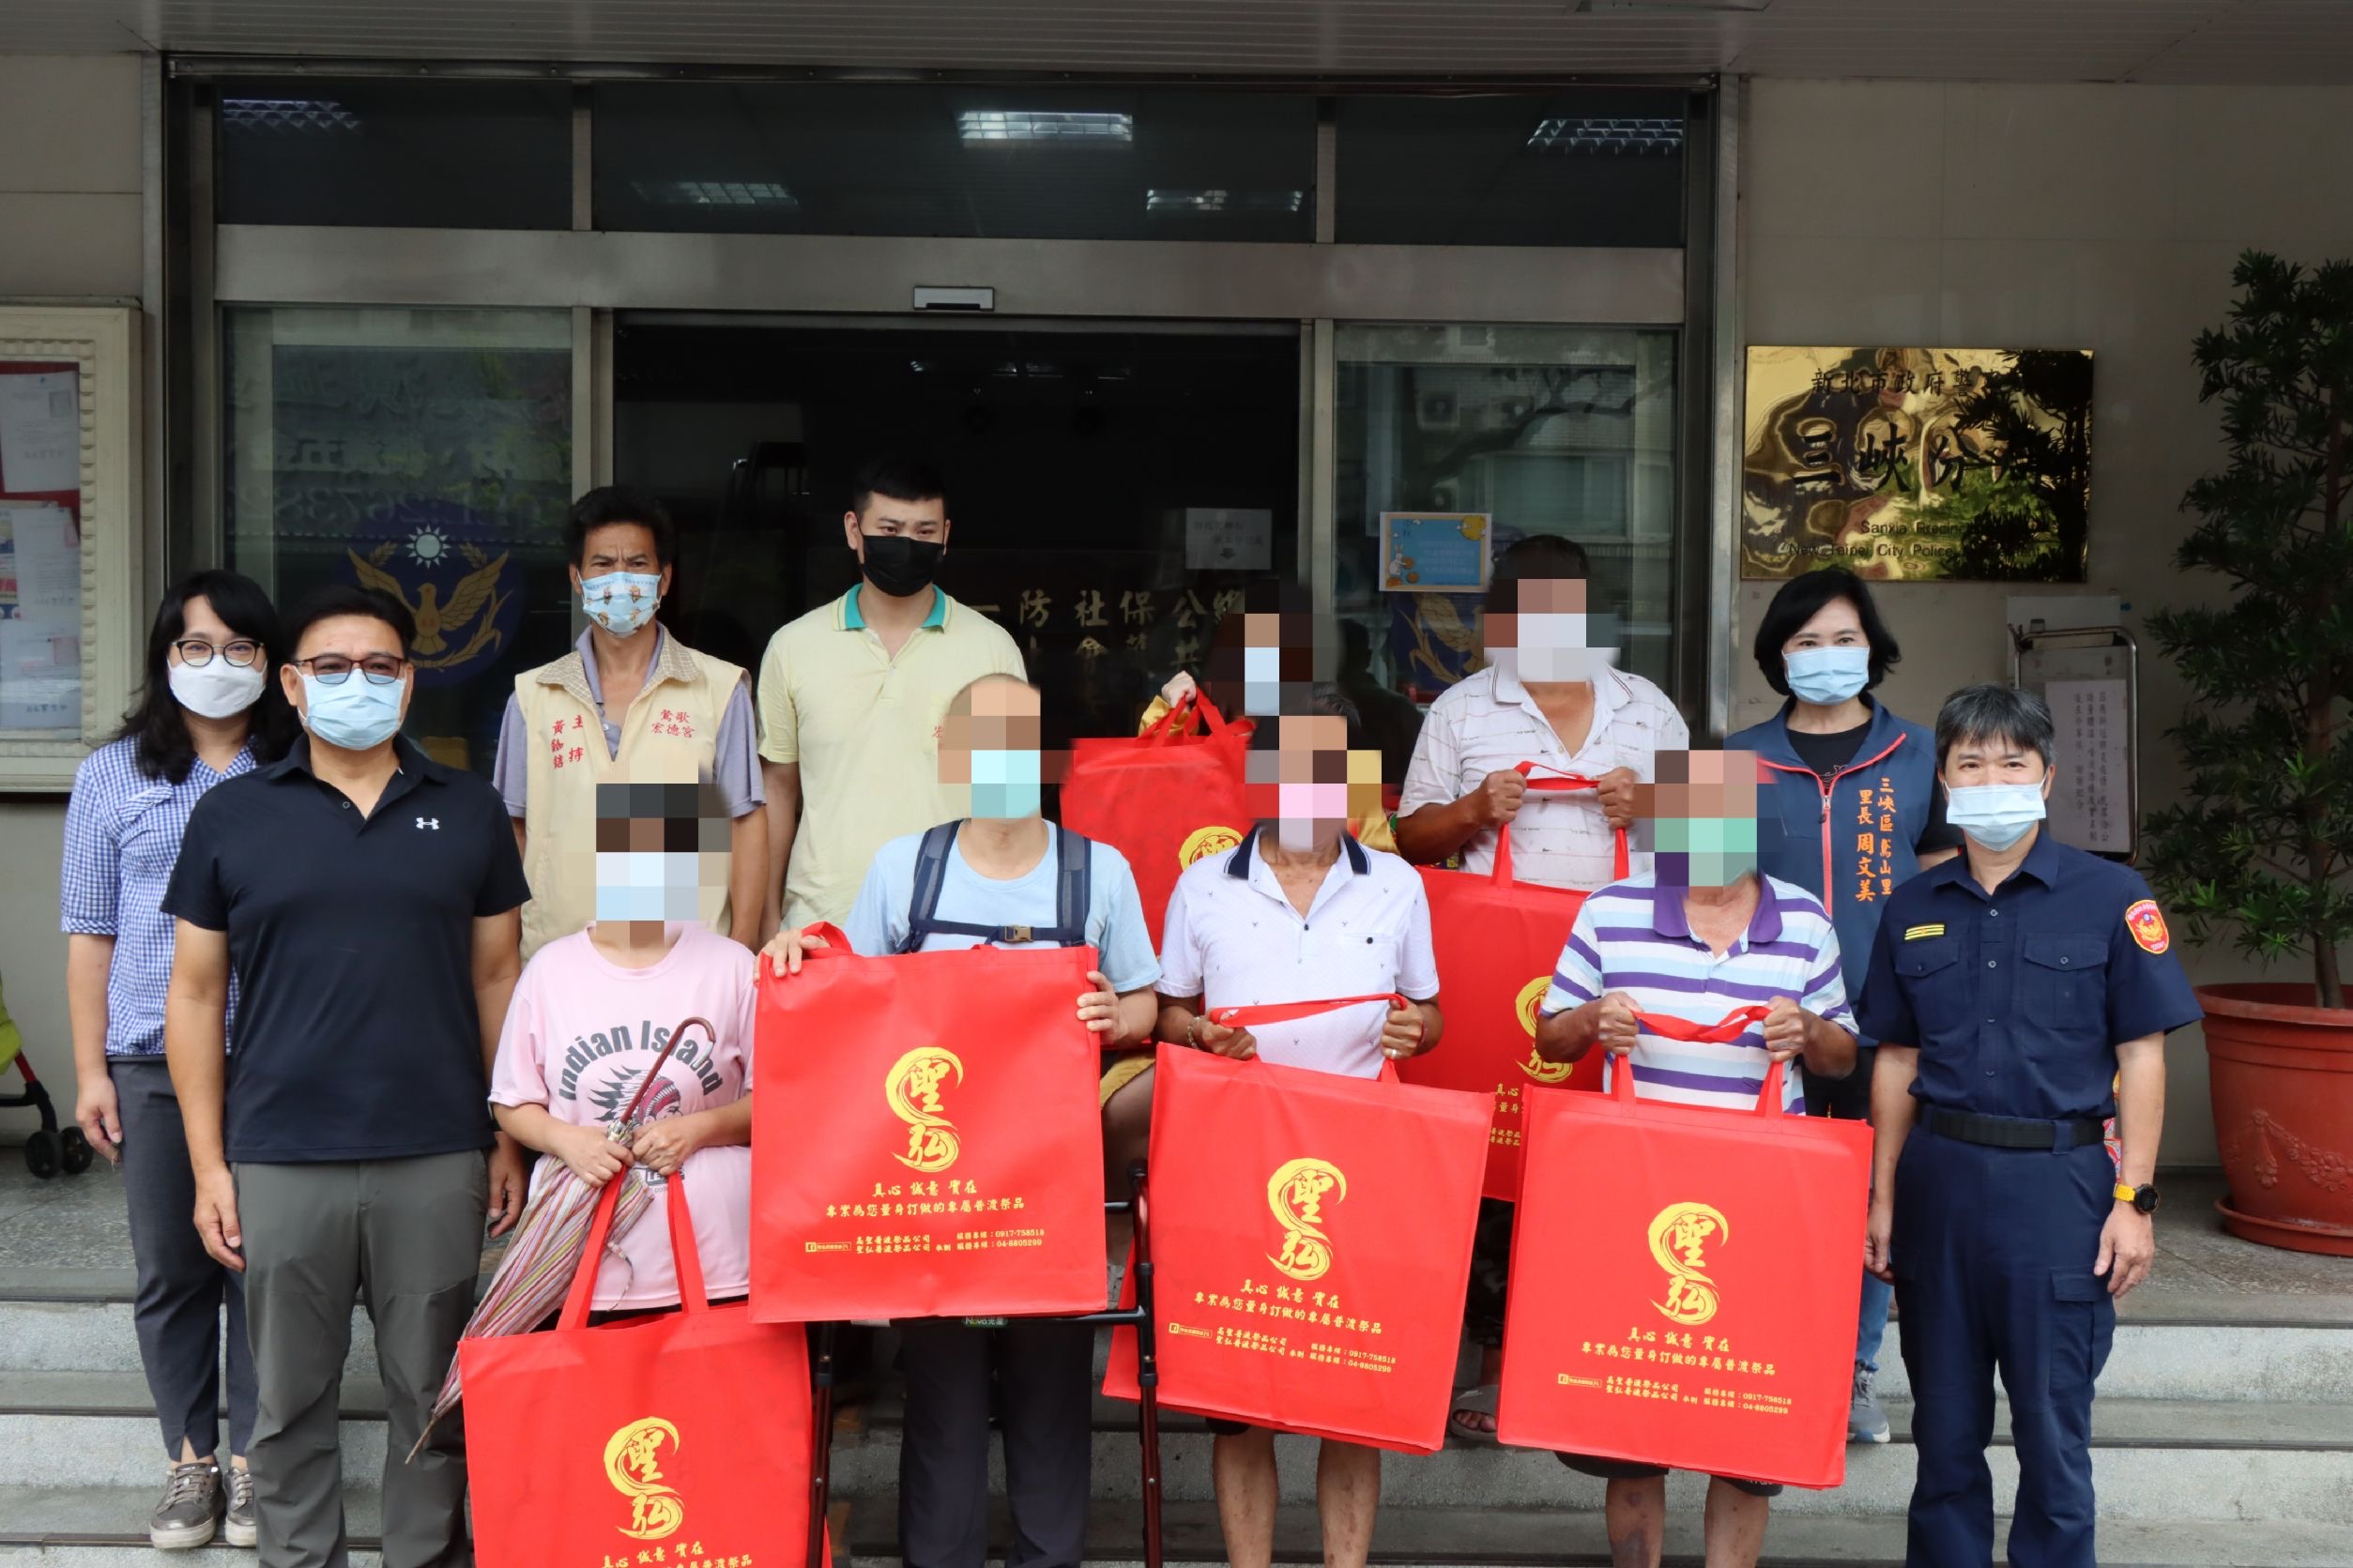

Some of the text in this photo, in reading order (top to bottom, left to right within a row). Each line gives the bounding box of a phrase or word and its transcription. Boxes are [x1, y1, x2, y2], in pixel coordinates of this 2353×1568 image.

[1811, 367, 1997, 396] 新北市政府警
[1793, 422, 1988, 493] 三峽分
[1860, 521, 1907, 535] Sanxia
[1876, 543, 1904, 558] City
[1913, 543, 1954, 556] Police
[661, 708, 690, 723] 鶯歌
[568, 714, 584, 763] 主持
[1877, 777, 1897, 832] 三峽區
[1855, 789, 1877, 902] 里長 周文美
[558, 1020, 723, 1101] Indian Isand
[873, 1182, 902, 1197] 真心
[909, 1180, 939, 1196] 誠意
[1240, 1278, 1269, 1295] 真心
[1276, 1285, 1305, 1303] 誠意
[1627, 1326, 1657, 1343] 真心
[1664, 1331, 1693, 1349] 誠意
[636, 1546, 665, 1564] 誠意
